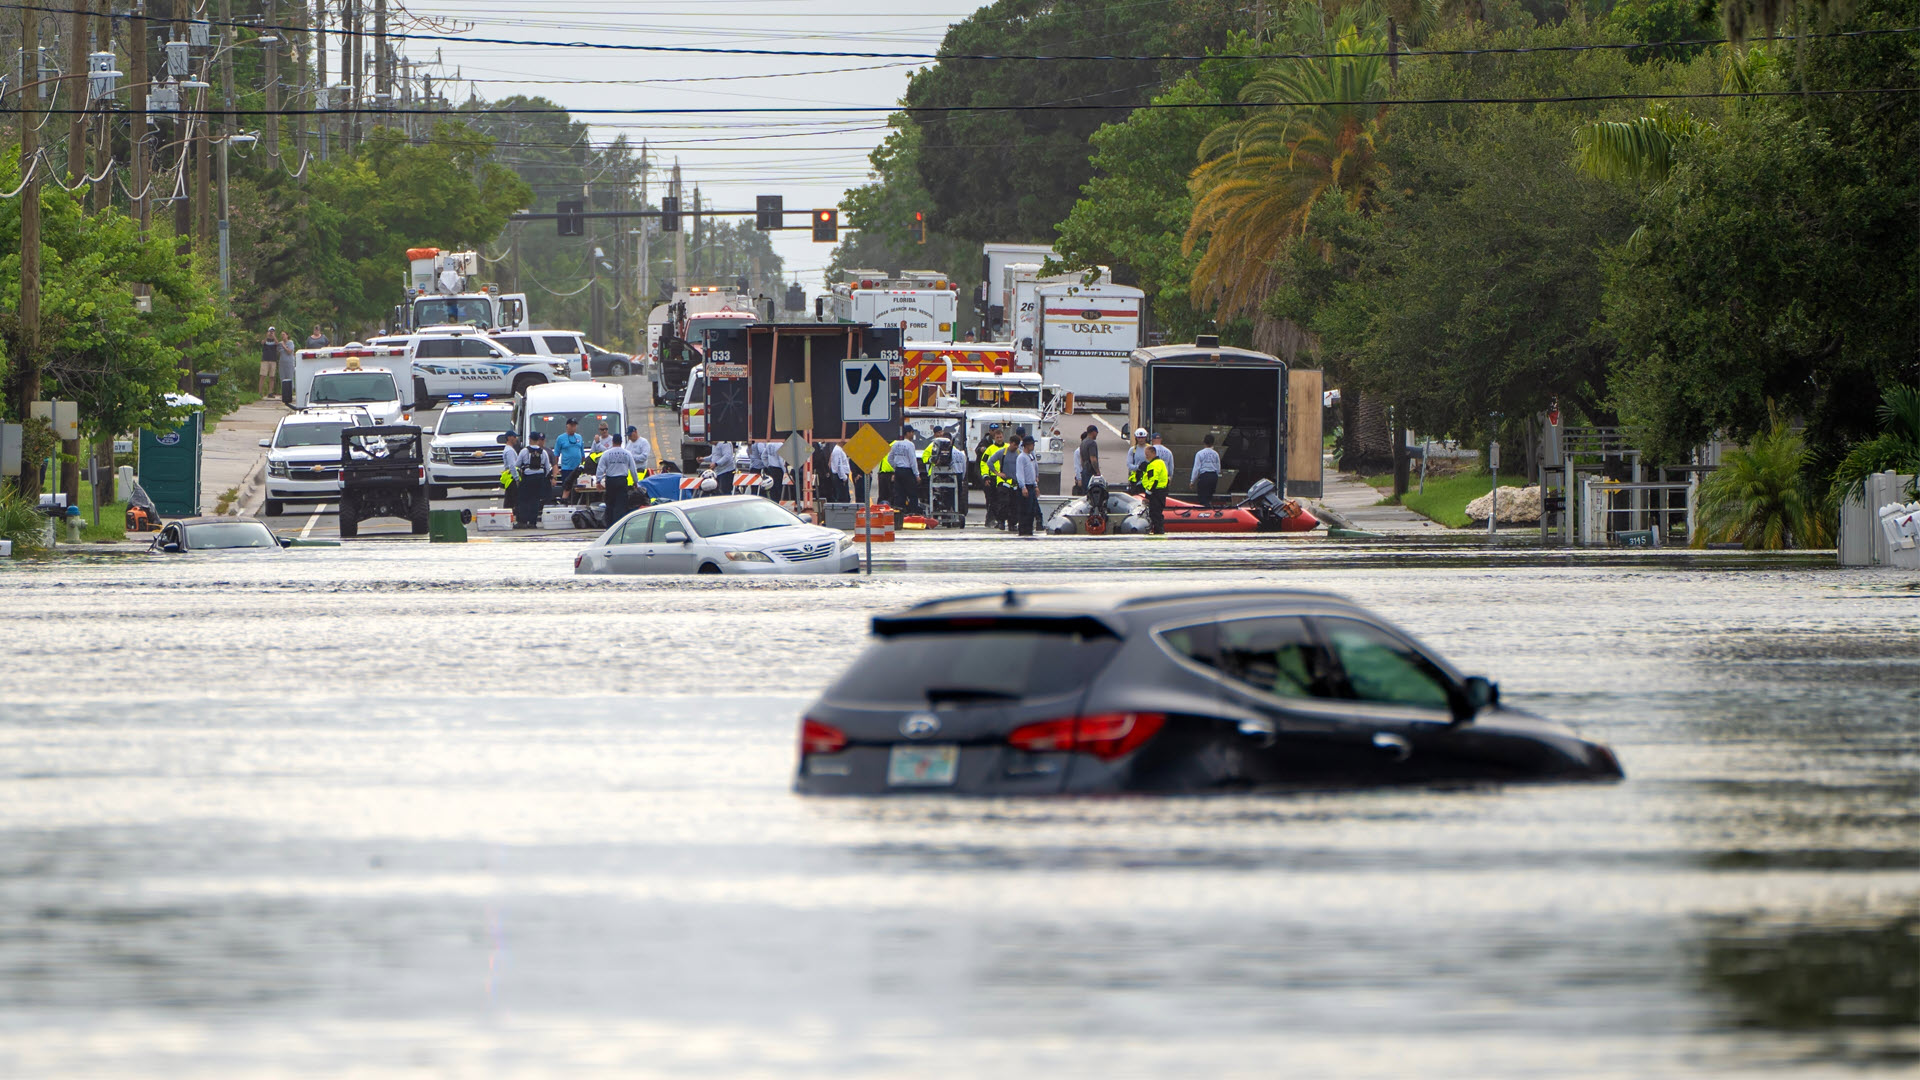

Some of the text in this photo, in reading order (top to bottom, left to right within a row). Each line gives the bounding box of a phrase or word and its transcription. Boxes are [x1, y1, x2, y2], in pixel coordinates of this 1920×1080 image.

[1020, 302, 1035, 312] 26
[1071, 323, 1113, 334] USAR
[711, 350, 731, 361] 633
[880, 350, 899, 360] 633
[1629, 536, 1647, 545] 3145
